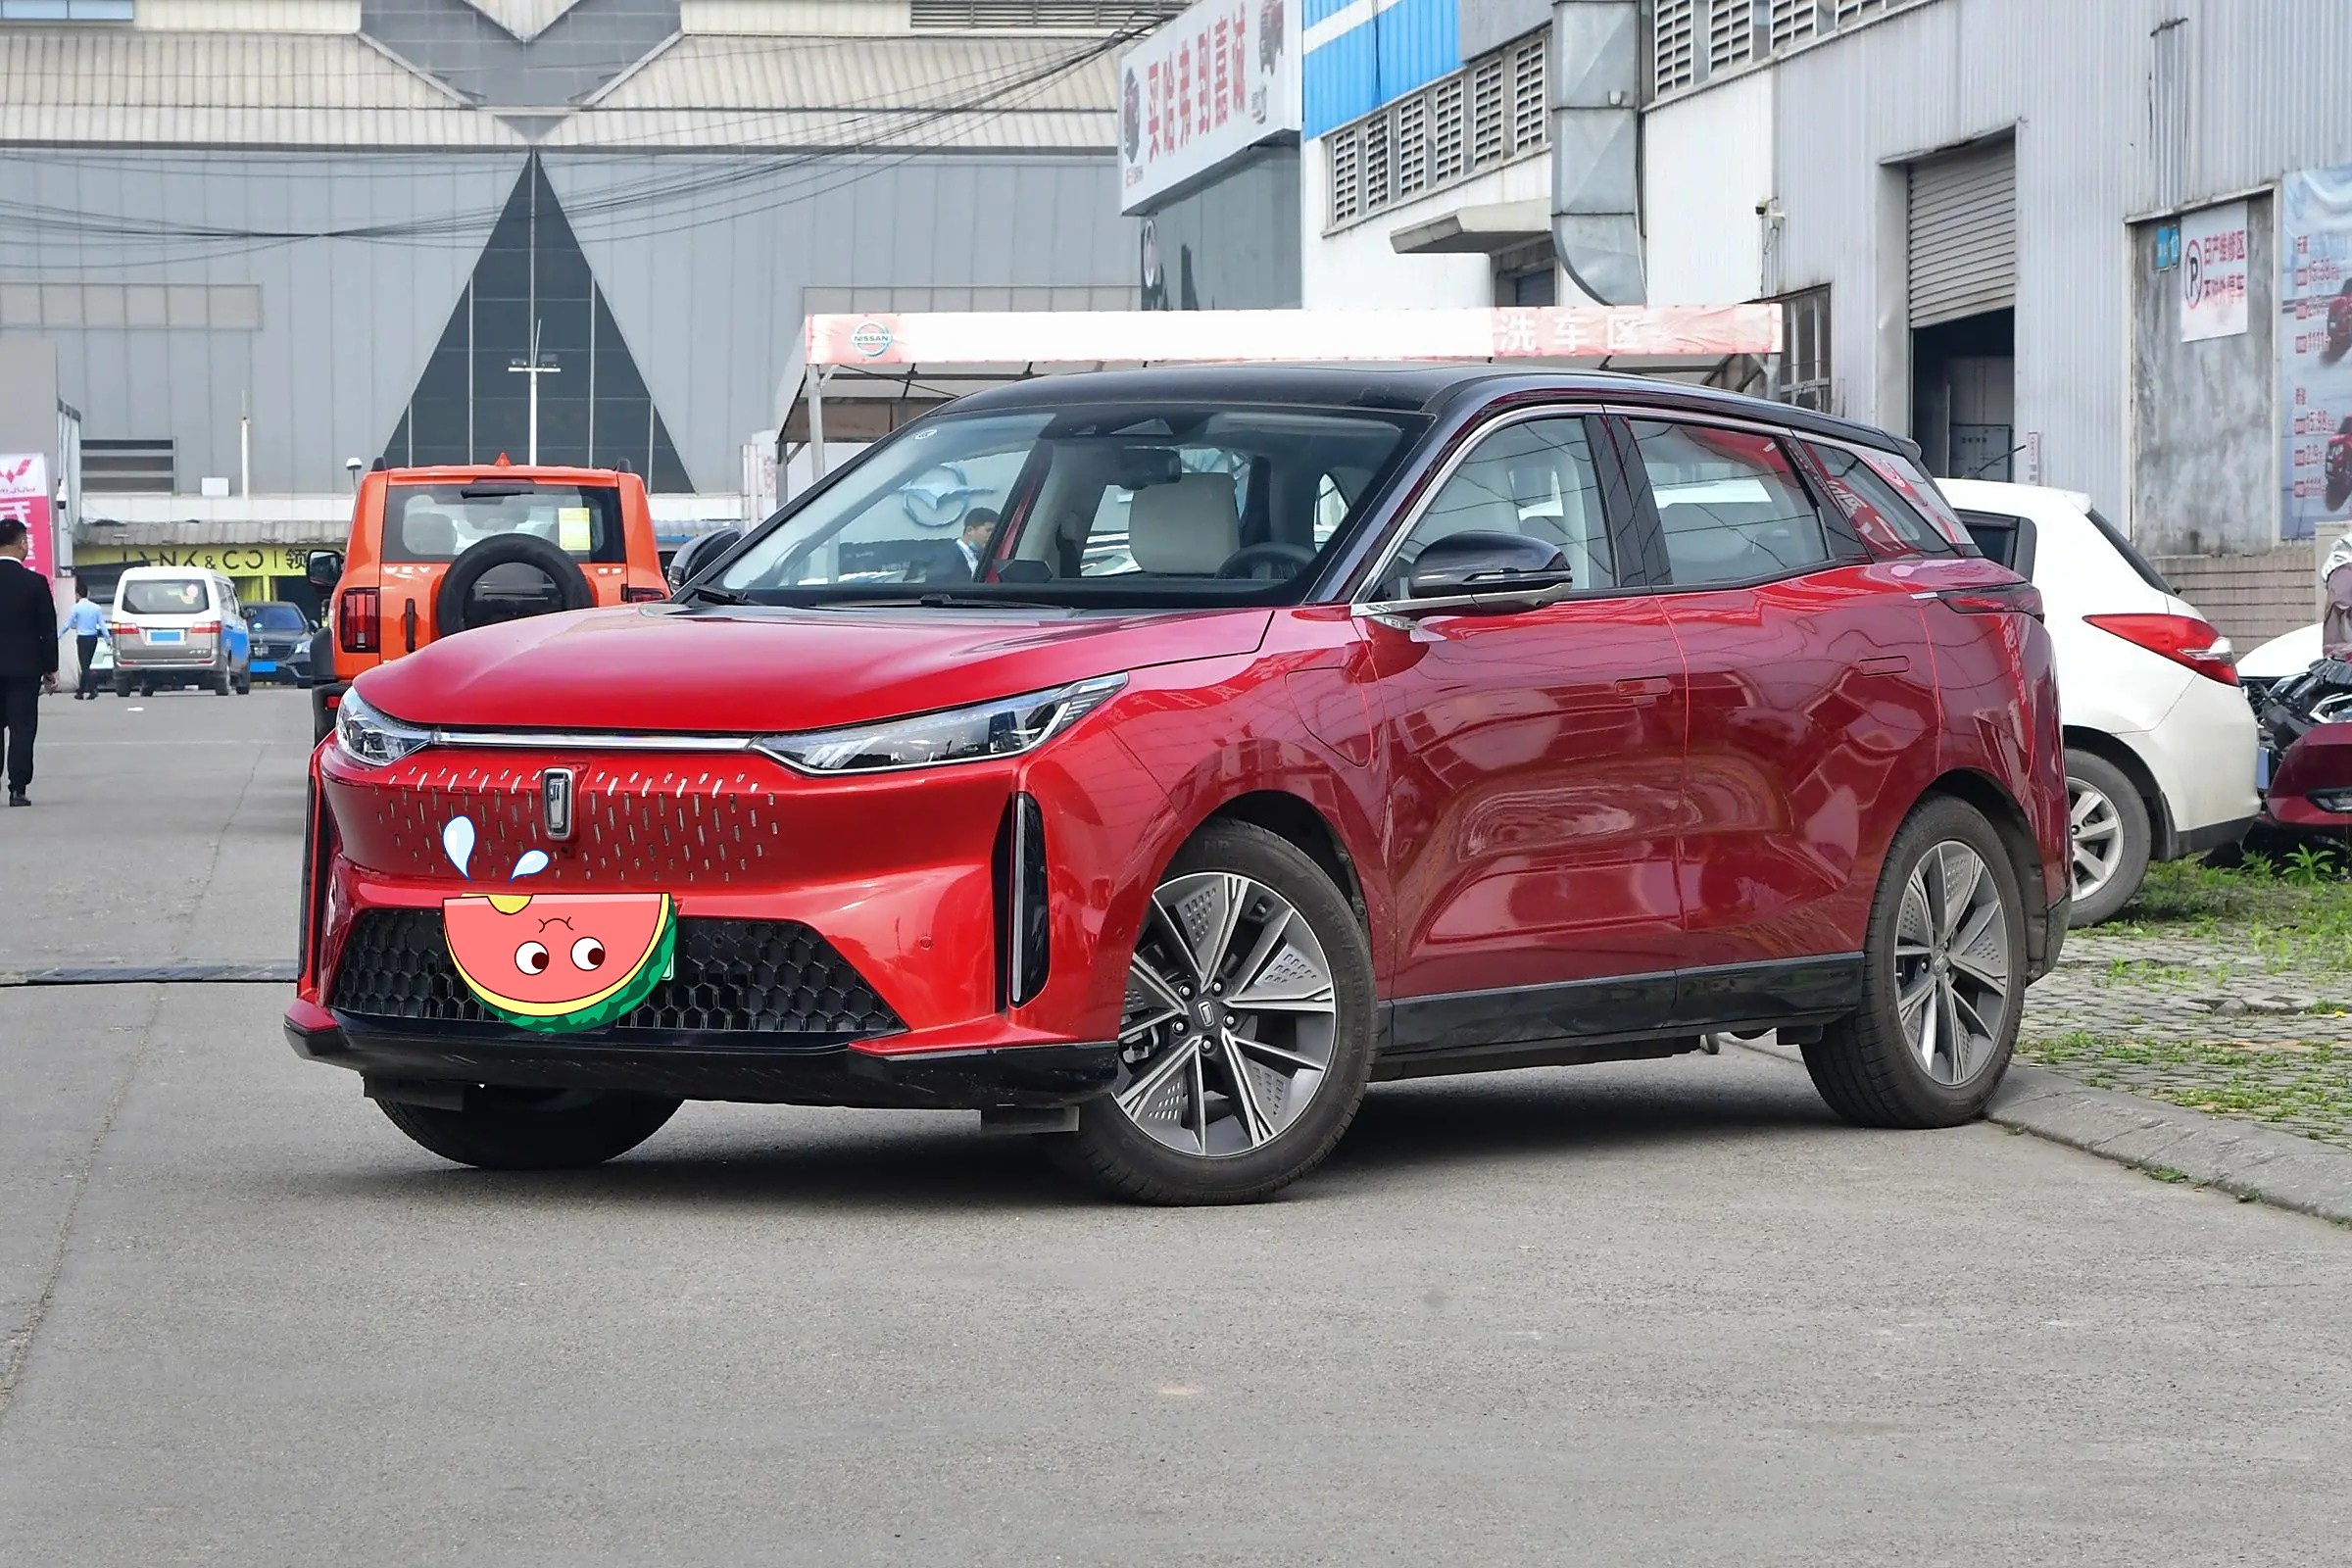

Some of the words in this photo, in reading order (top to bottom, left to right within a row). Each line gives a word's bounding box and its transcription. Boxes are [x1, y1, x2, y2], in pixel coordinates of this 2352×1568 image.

[2204, 229, 2245, 266] 日产维修区
[1498, 314, 1644, 352] 洗车区
